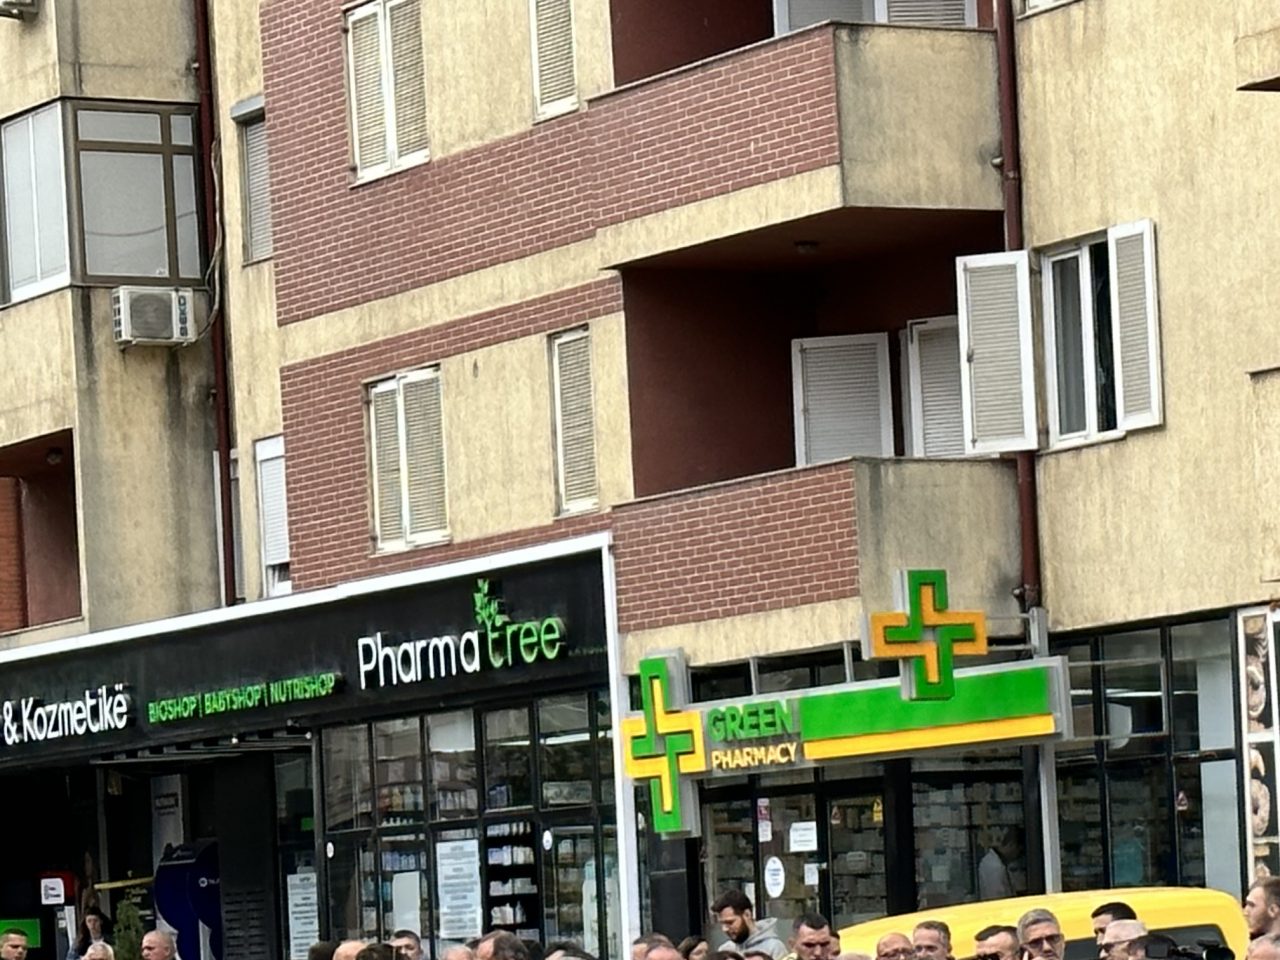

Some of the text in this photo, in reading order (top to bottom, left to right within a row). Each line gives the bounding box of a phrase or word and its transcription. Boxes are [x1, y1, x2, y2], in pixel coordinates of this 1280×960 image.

[3, 682, 128, 746] & Kozmetikë
[148, 672, 336, 724] BIOSHOP BABYSHOP NUTRISHOP
[708, 699, 796, 743] GREEN
[711, 741, 797, 770] PHARMACY
